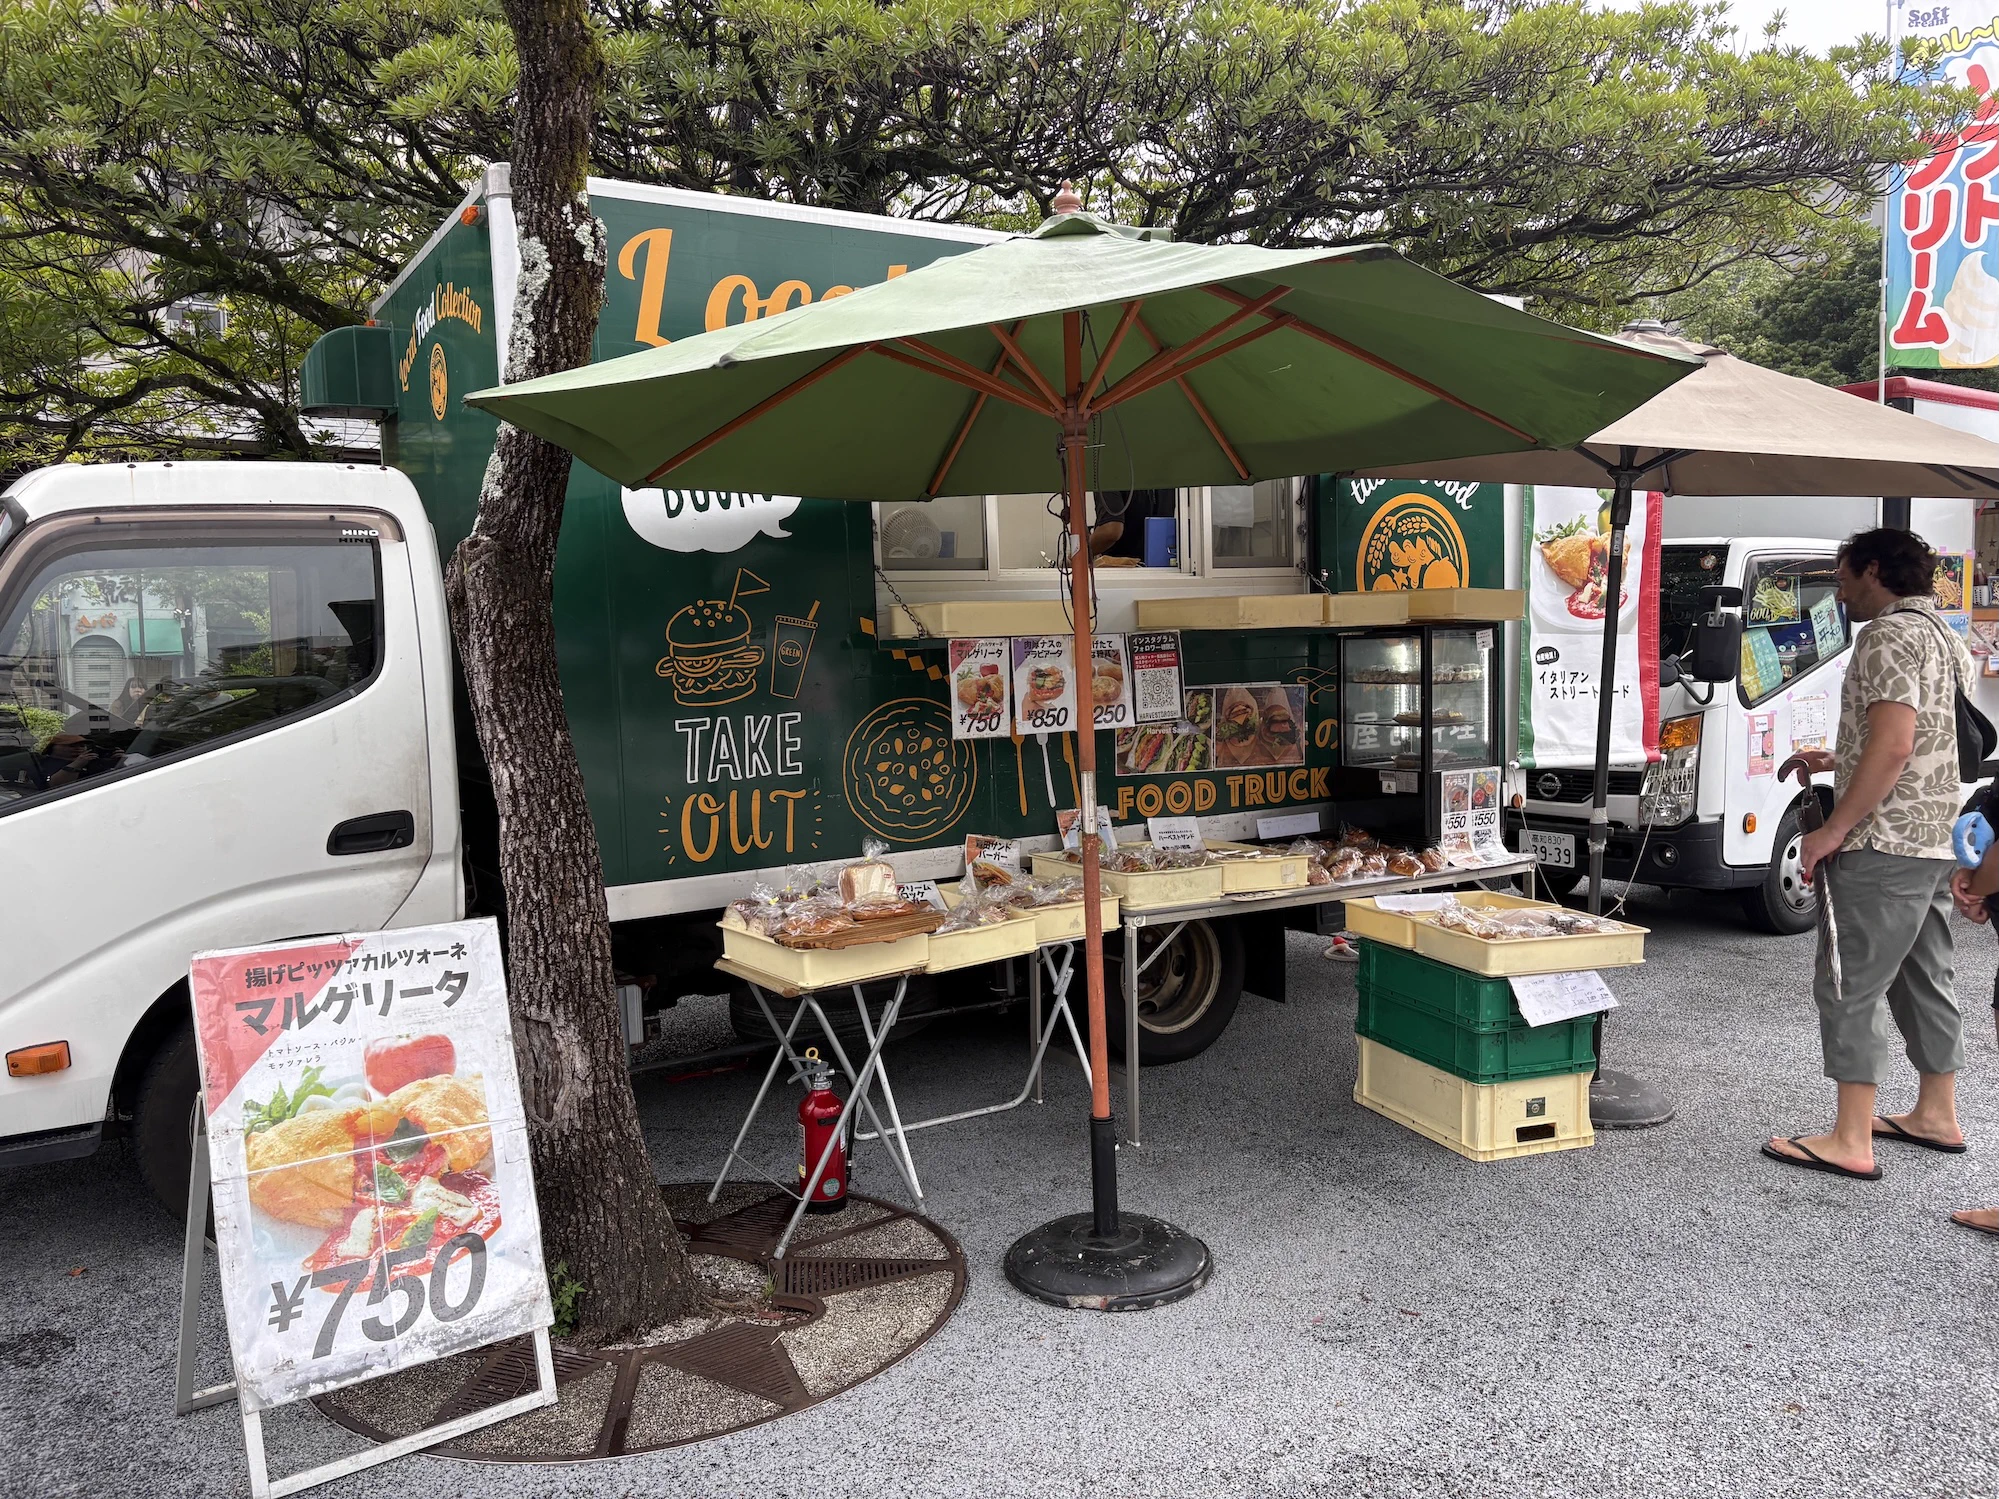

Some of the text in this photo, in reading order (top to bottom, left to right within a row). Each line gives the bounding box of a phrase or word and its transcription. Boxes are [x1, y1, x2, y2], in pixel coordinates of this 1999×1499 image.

[1909, 6, 1950, 21] Soft
[1908, 19, 1948, 27] cream
[415, 291, 436, 346] Food
[436, 281, 482, 335] Collection
[1132, 635, 1175, 646] インスタグラム
[781, 645, 802, 659] GREEN
[1024, 649, 1063, 660] アラビアータ
[1539, 670, 1589, 685] イタリアン
[1549, 685, 1629, 701] ストリートード
[960, 710, 1002, 733] ¥750
[1027, 706, 1069, 728] ¥850
[1093, 703, 1127, 725] 250
[1146, 726, 1190, 735] Harvest Sand
[674, 712, 803, 784] TAKE
[1117, 766, 1332, 821] FOOD TRUCK
[680, 788, 807, 863] OUT
[1158, 833, 1196, 842] ハーベストサンド
[1547, 835, 1561, 846] 830
[978, 849, 1008, 862] バーガー
[245, 942, 468, 989] 揚げピッツァカルツォーネ
[235, 969, 470, 1036] マルゲリータ
[267, 1055, 322, 1070] モッツァレラ
[267, 1232, 488, 1360] ¥750
